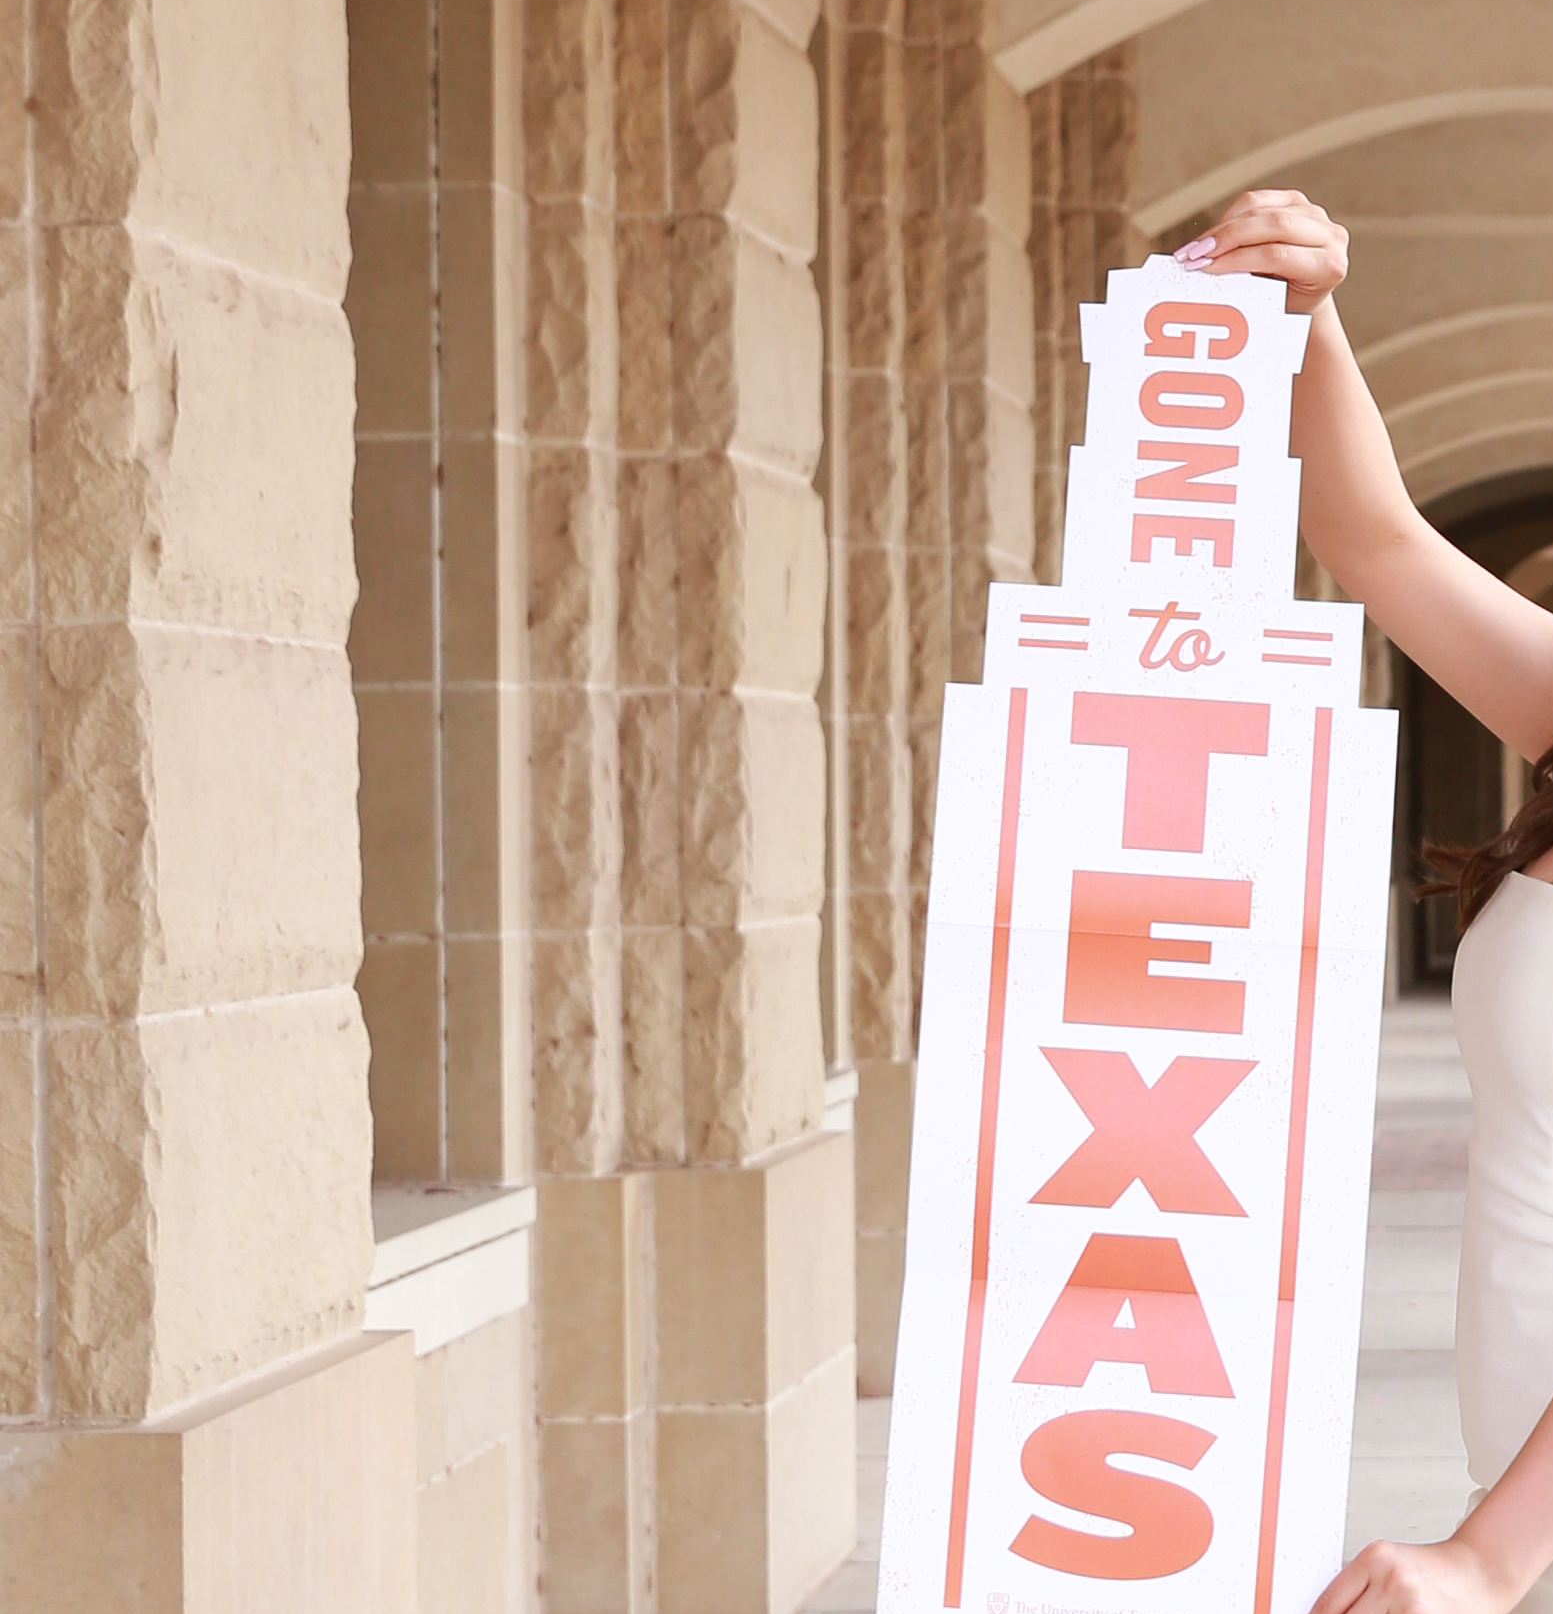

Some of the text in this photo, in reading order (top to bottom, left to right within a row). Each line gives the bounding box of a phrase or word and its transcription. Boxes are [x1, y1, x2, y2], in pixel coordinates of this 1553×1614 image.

[1130, 300, 1250, 568] GONE
[1127, 600, 1226, 673] to
[1006, 690, 1271, 1582] TEXAS
[1013, 1600, 1038, 1614] The
